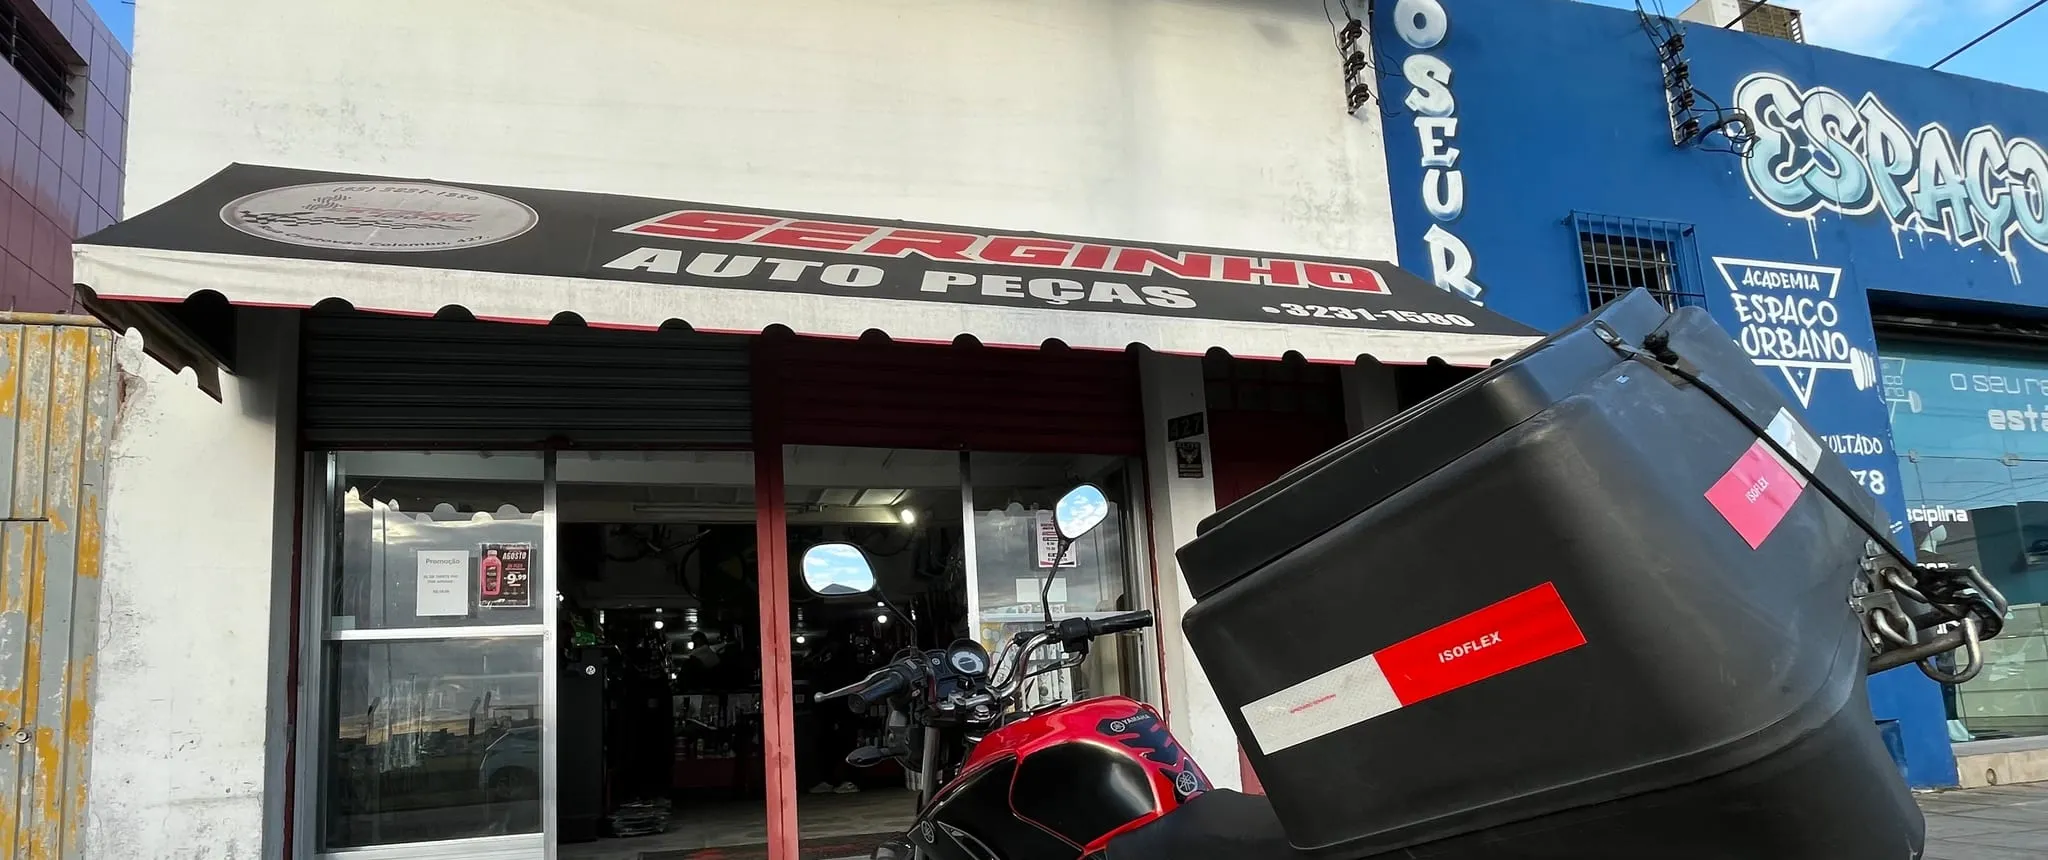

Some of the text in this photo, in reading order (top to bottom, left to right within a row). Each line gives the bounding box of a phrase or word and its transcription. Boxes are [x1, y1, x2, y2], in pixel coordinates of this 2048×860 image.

[1733, 71, 2048, 258] ESPAÇO
[612, 209, 1392, 295] SERGINHO
[602, 246, 1197, 309] AUTO PEÇAS
[1742, 267, 1820, 291] ACADEMIA
[1280, 303, 1475, 327] 3231-1580
[1730, 292, 1838, 328] ESPAÇO
[1741, 324, 1849, 361] URBANO
[1972, 374, 2020, 394] seu
[1170, 415, 1202, 439] 427
[1821, 433, 1883, 456] ULTADO
[1745, 475, 1769, 503] ISOFLEX
[425, 557, 461, 565] Promoção
[502, 551, 527, 561] AGOSTO
[1438, 631, 1502, 663] ISOFLEX
[1122, 714, 1151, 725] YAMAHA
